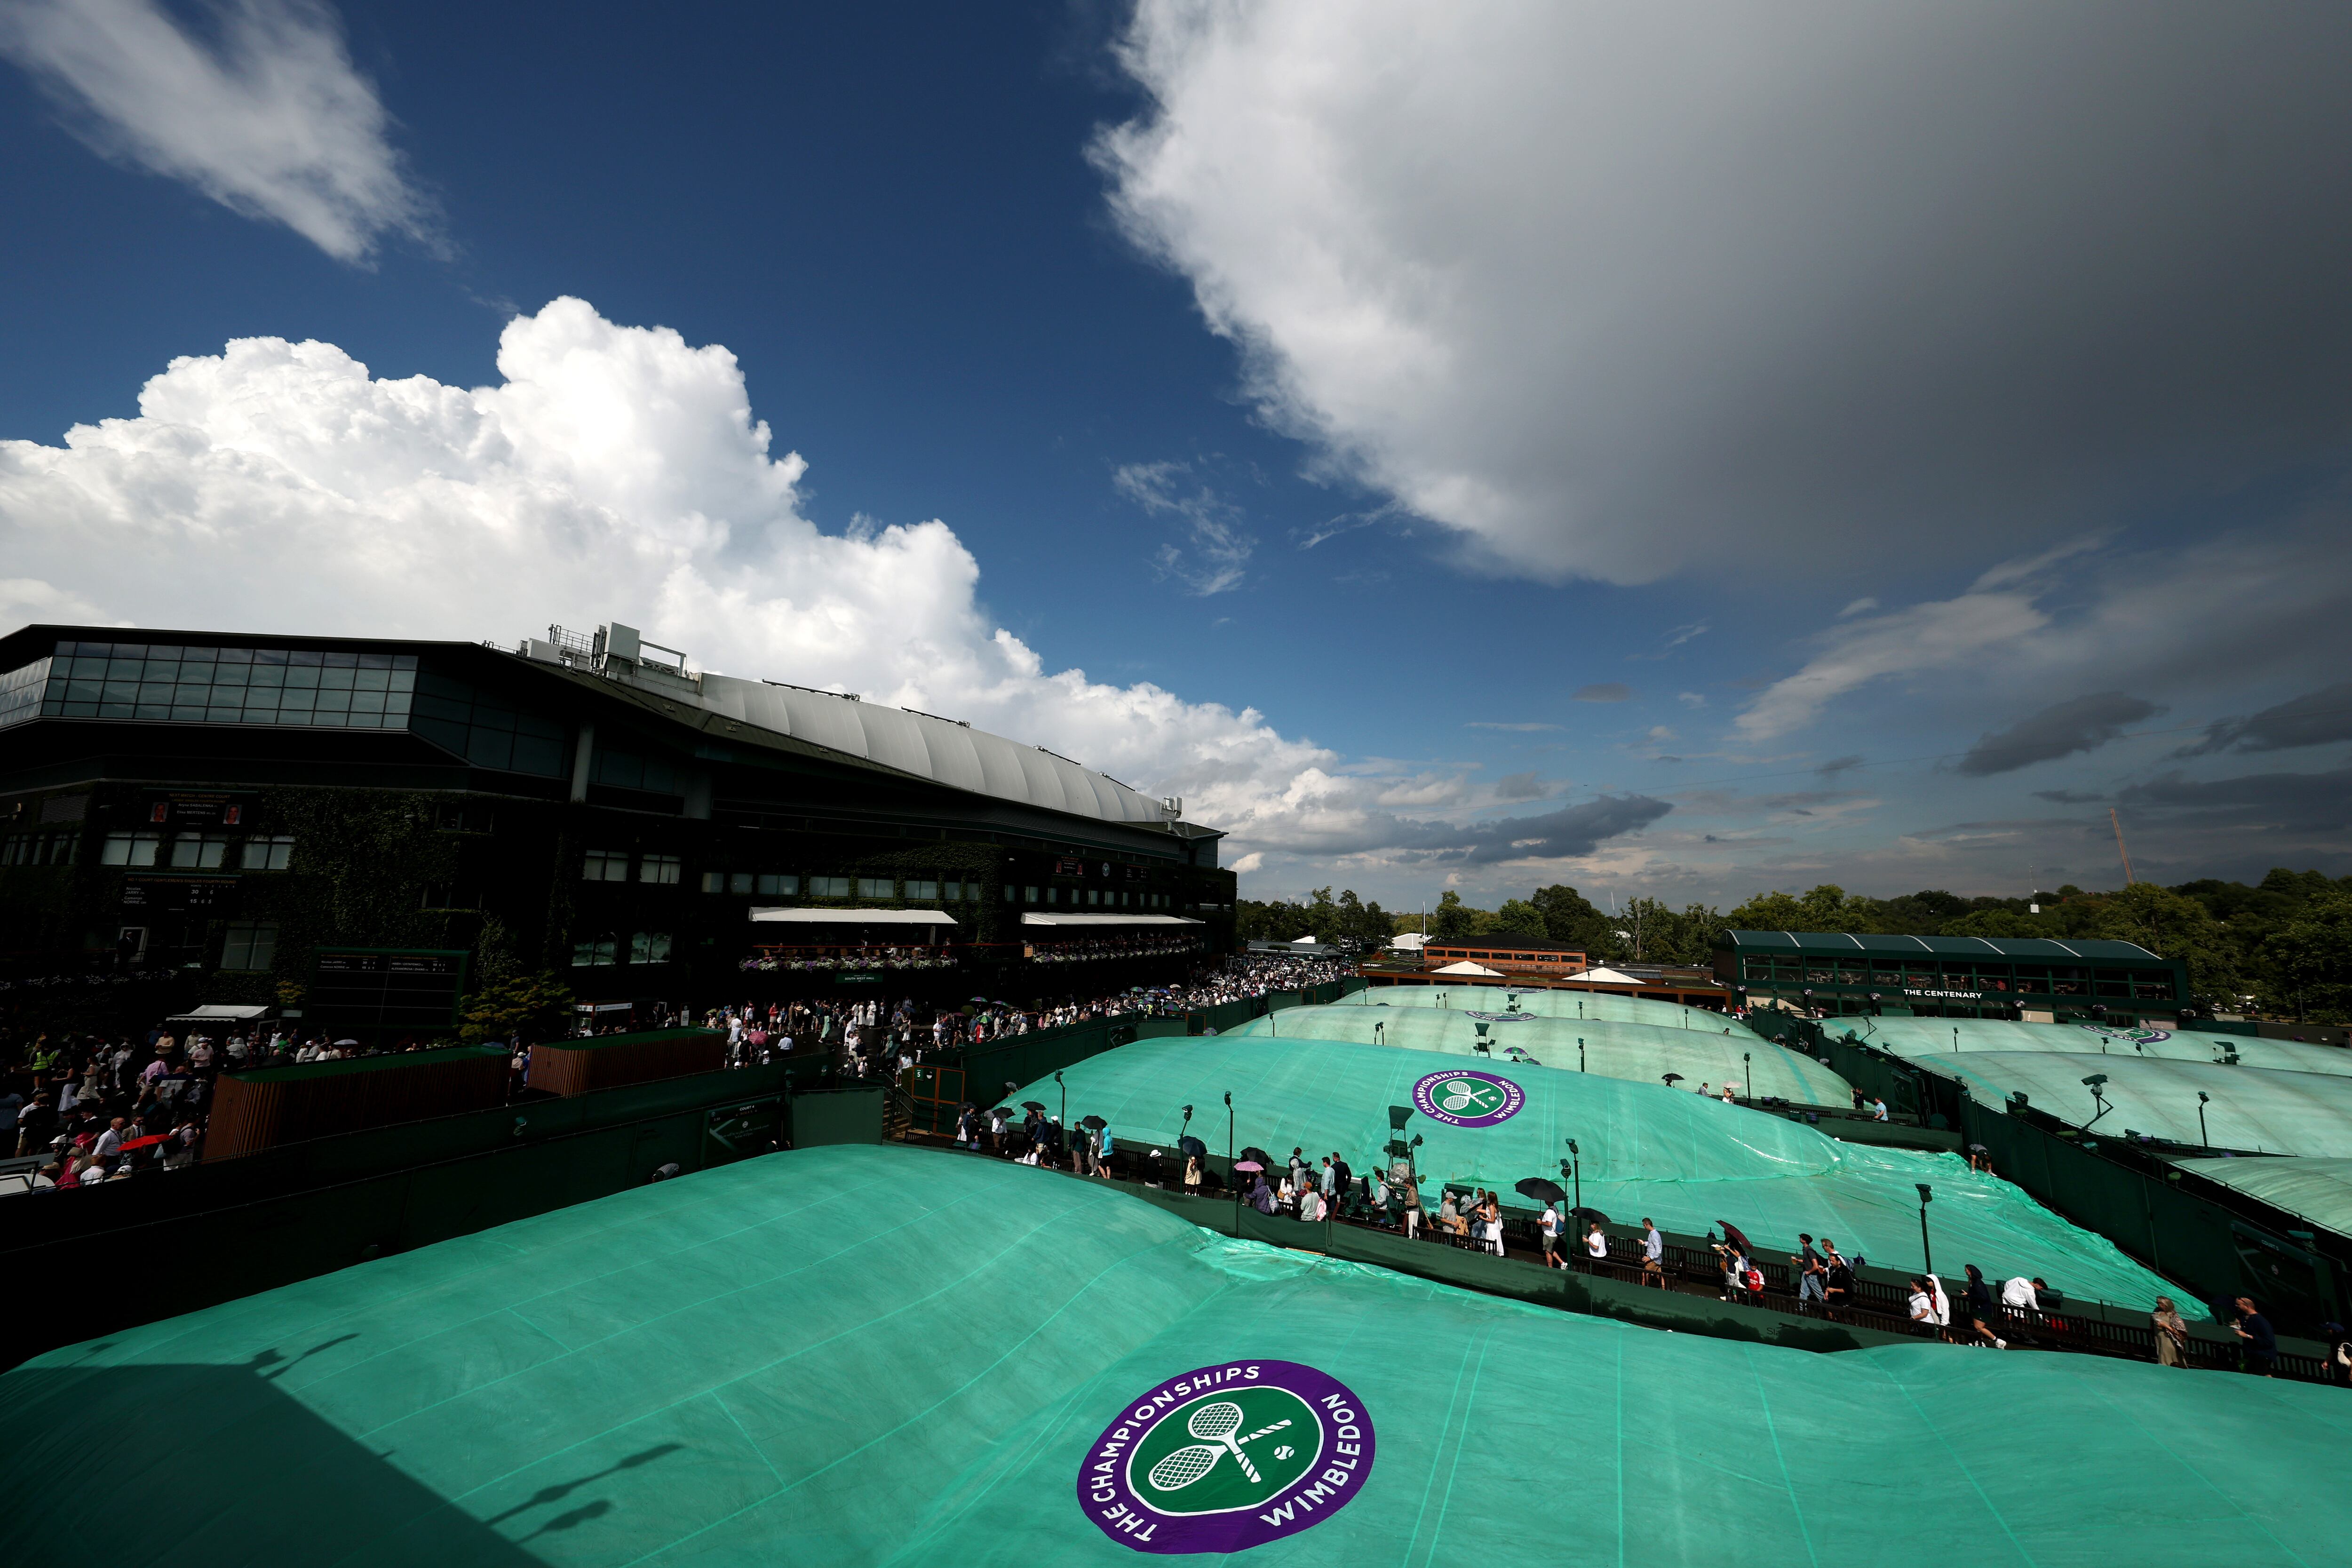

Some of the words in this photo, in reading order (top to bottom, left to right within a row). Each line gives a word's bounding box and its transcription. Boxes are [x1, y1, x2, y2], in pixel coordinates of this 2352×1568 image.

[1924, 990, 1982, 999] CENTENARY
[1417, 1071, 1469, 1114] CHAMPIONSHIPS
[1494, 1080, 1520, 1119] WIMBLEDON
[1434, 1113, 1459, 1124] THE
[1091, 1365, 1261, 1502] CHAMPIONSHIPS
[1259, 1393, 1361, 1526] WIMBLEDON
[1102, 1503, 1158, 1542] THE
